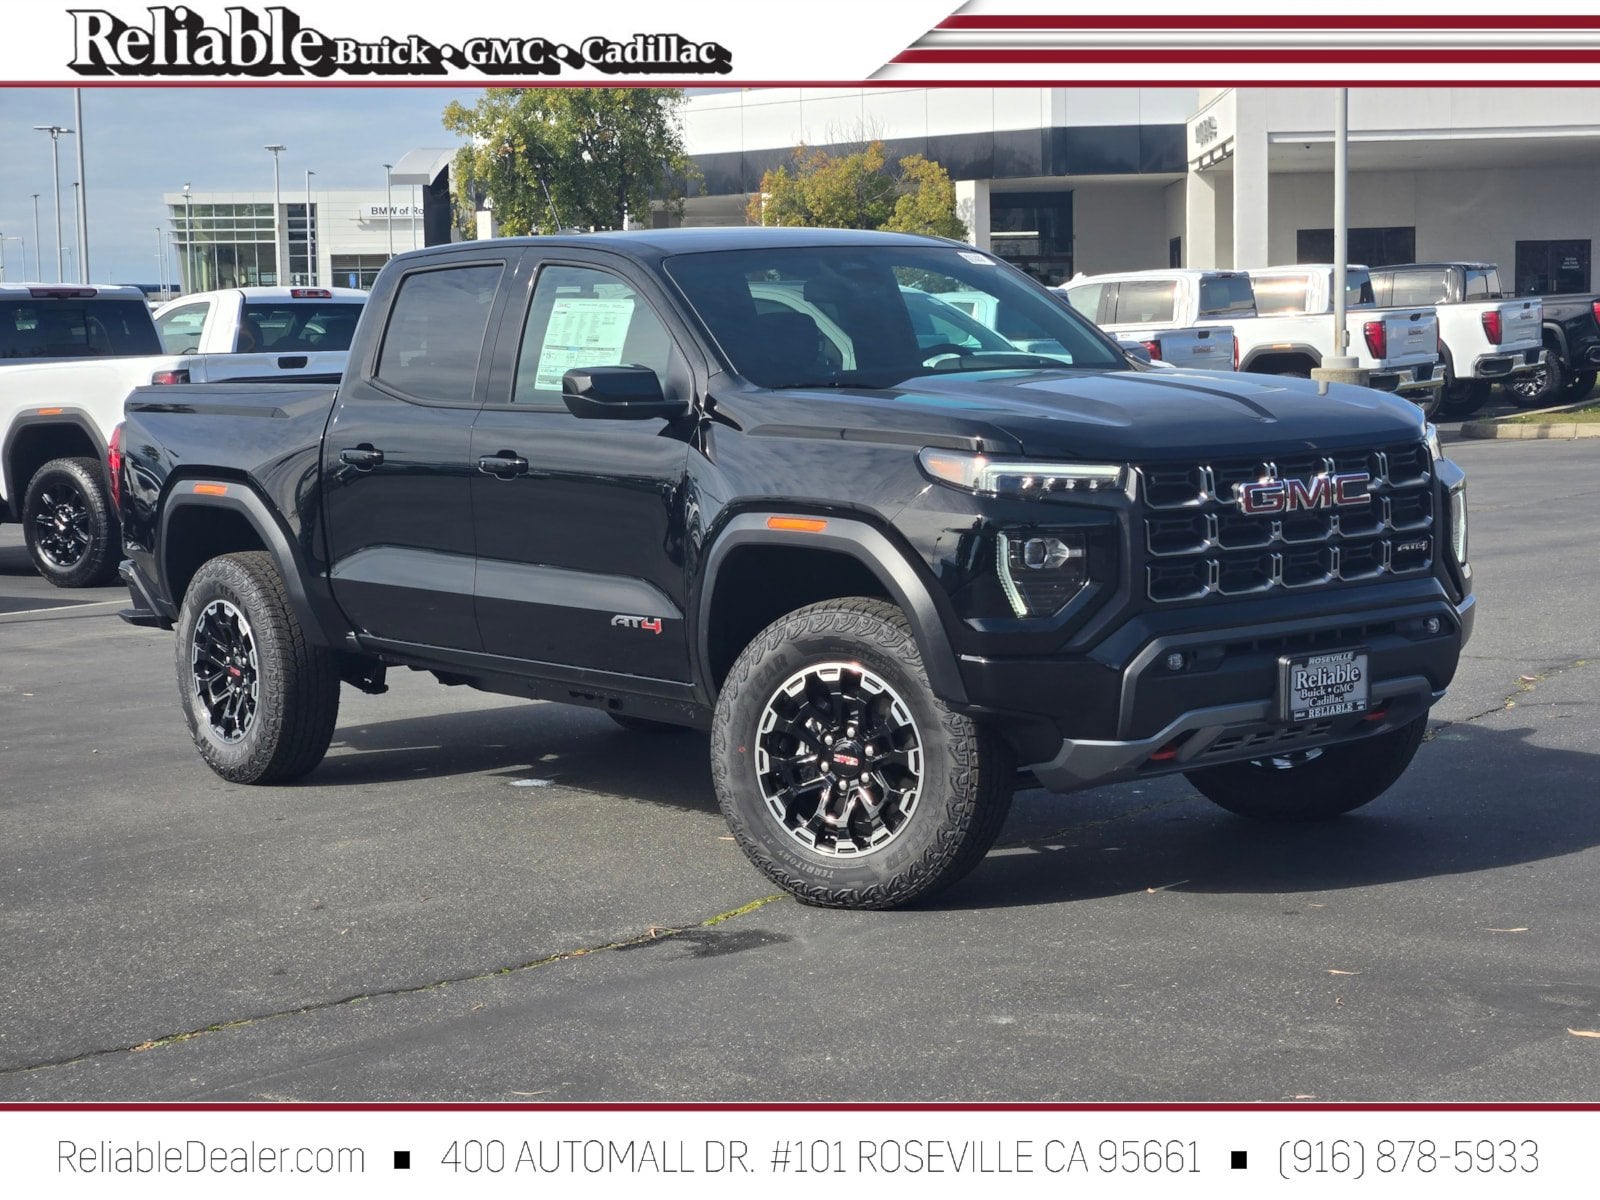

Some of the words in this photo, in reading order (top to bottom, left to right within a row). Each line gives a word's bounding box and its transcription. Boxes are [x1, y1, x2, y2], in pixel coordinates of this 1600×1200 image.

[371, 206, 398, 215] BMW
[400, 206, 409, 215] of
[1240, 472, 1372, 516] GMC
[1397, 540, 1428, 552] AT4
[610, 614, 663, 635] AT4
[1308, 652, 1354, 665] ROSEVILLE
[1295, 663, 1360, 690] Reliable
[1301, 686, 1326, 699] Buick
[1333, 682, 1355, 694] GMC
[1309, 694, 1344, 707] Cadillac
[1308, 703, 1353, 718] RELIABLE
